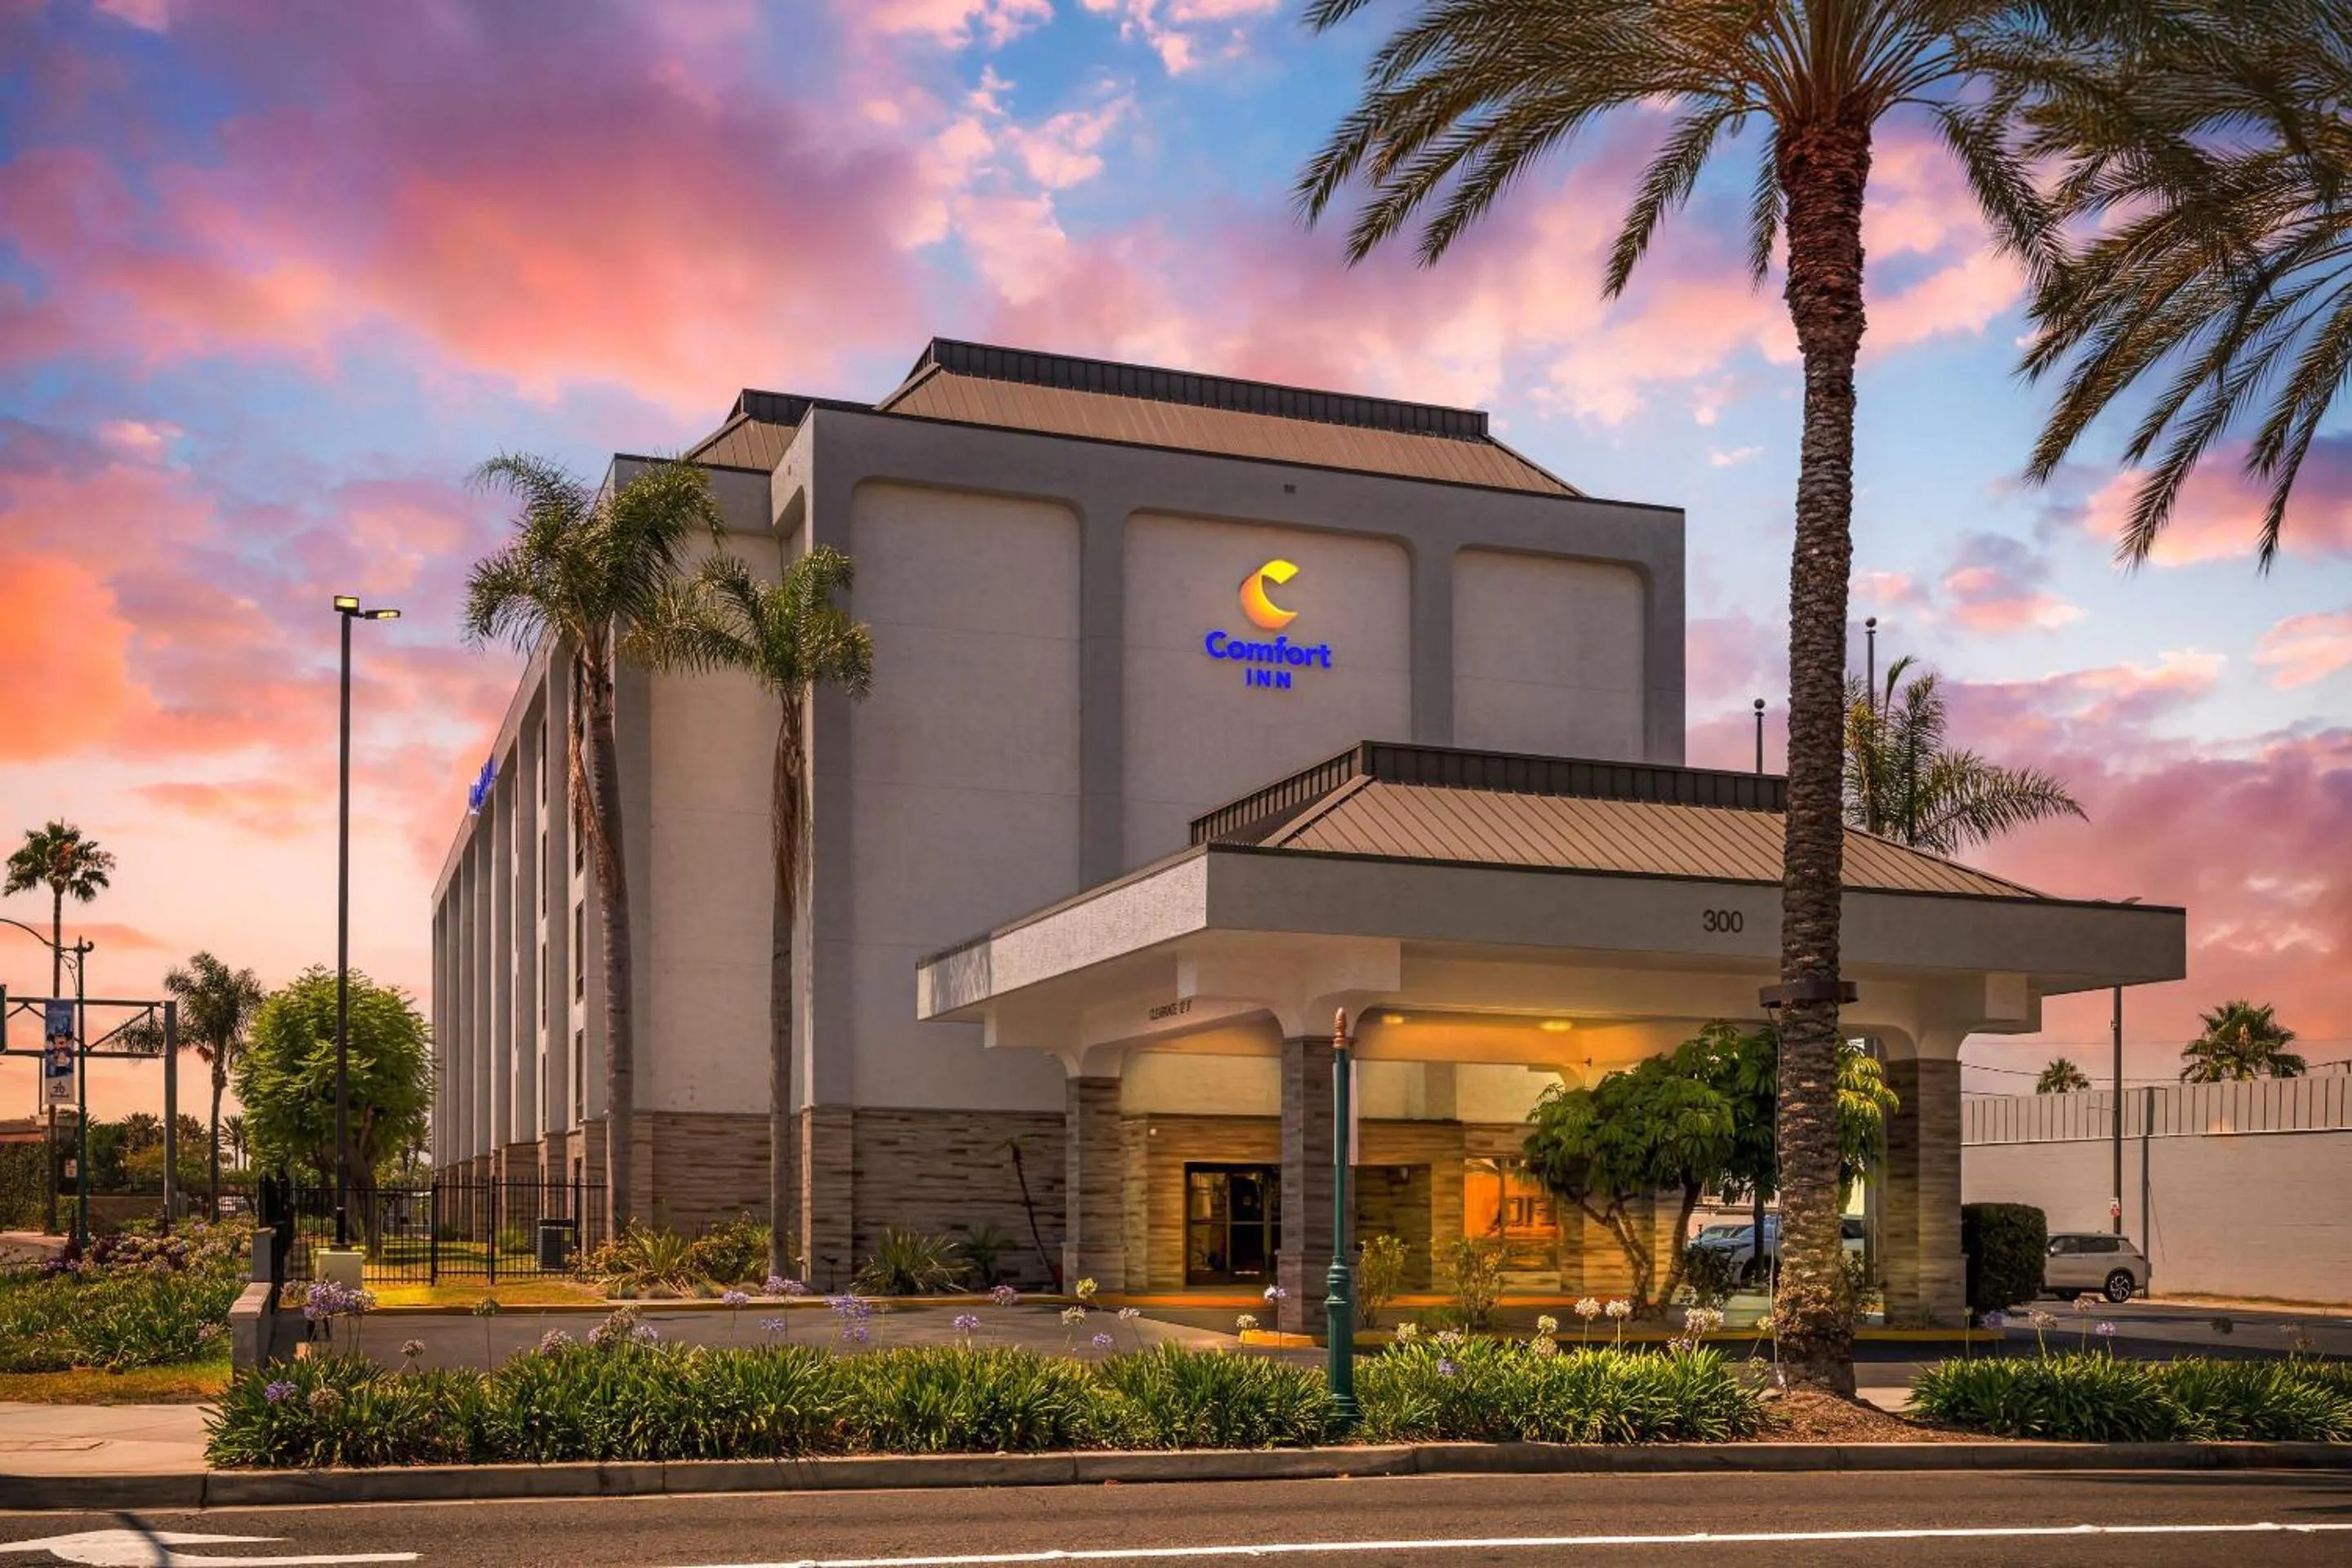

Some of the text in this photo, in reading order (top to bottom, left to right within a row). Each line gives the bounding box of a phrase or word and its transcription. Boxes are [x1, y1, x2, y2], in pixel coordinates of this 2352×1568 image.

[1205, 630, 1332, 668] Comfort
[1245, 668, 1292, 688] INN
[1702, 908, 1744, 933] 300
